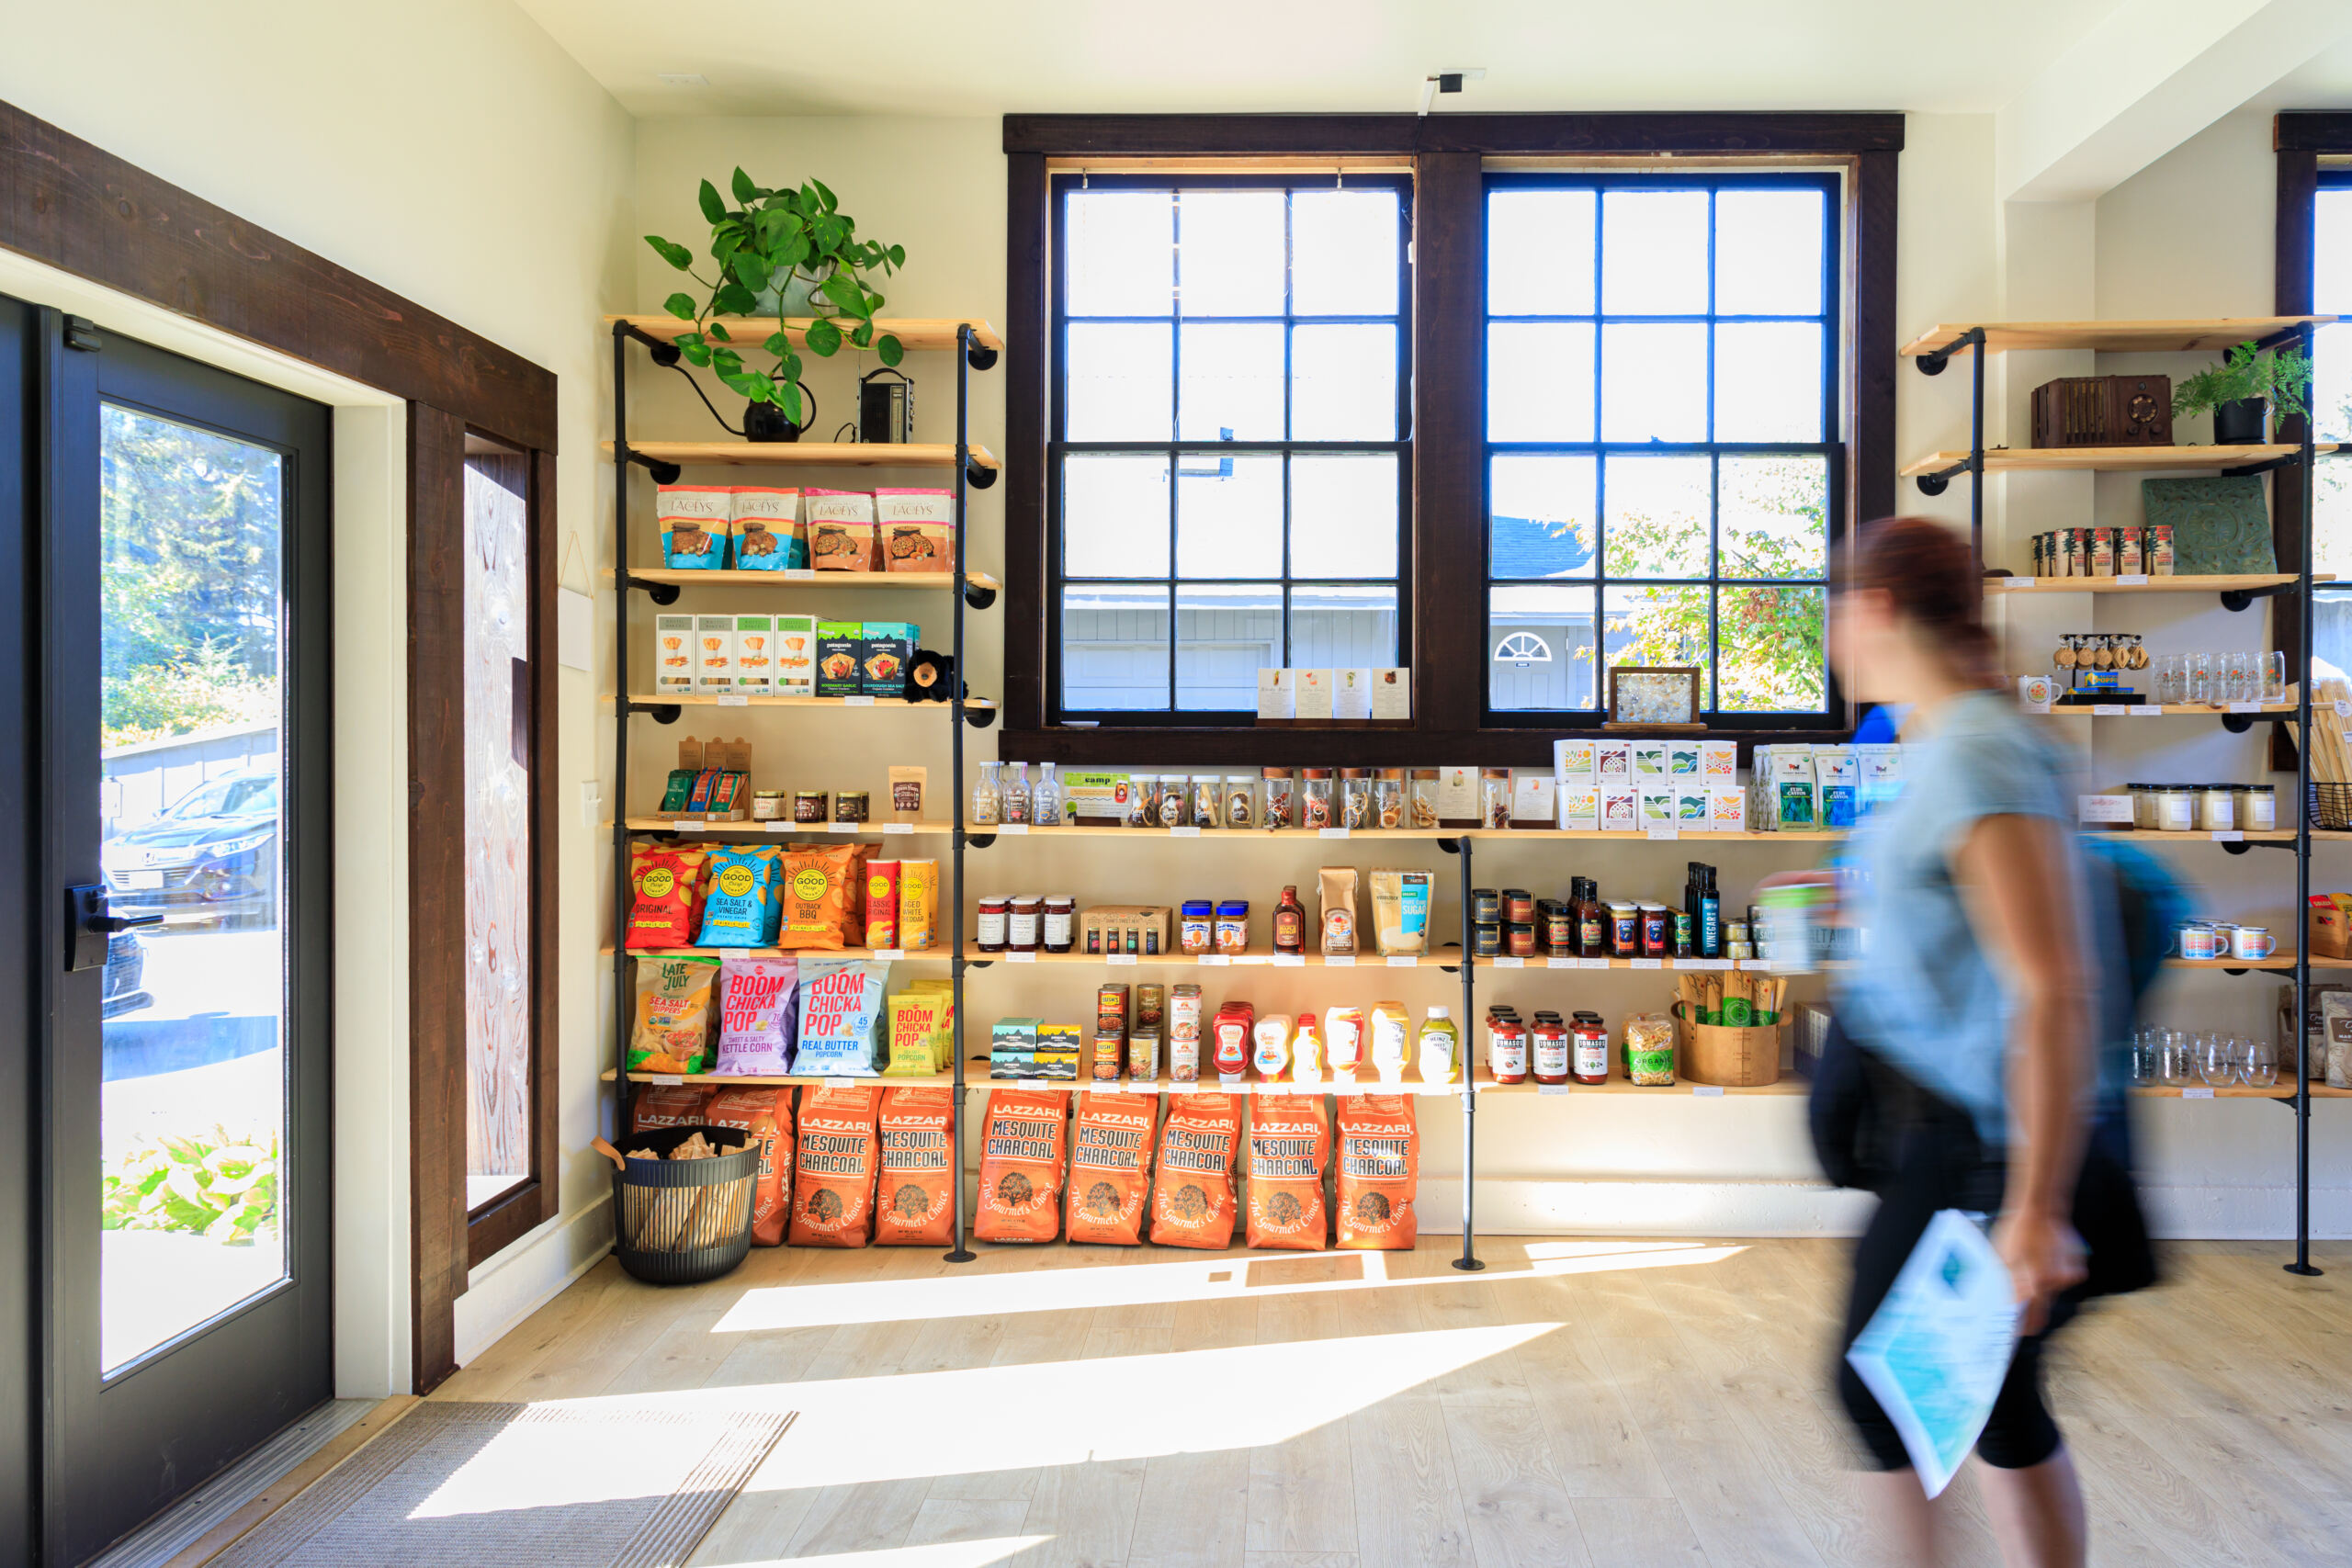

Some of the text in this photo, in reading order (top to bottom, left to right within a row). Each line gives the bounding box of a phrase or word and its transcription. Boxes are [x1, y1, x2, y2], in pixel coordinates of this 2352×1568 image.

[1085, 777, 1110, 785] camp
[636, 904, 673, 914] ORIGINAL
[717, 897, 728, 906] SEA
[730, 898, 746, 907] SALT
[1403, 905, 1426, 915] SUGAR
[718, 907, 747, 915] VINEGAR
[800, 909, 816, 919] BBQ
[1706, 917, 1716, 947] VINEGAR
[662, 963, 687, 978] LATE
[663, 975, 690, 990] JULY
[730, 975, 785, 996] BOOM
[812, 973, 865, 995] BOOM
[650, 997, 690, 1008] SEA SALT
[653, 1005, 681, 1014] DIPPERS
[726, 994, 775, 1010] CHICKA
[809, 996, 861, 1013] CHICKA
[724, 1011, 757, 1032] POP
[804, 1013, 842, 1036] POP
[858, 1017, 867, 1025] 45
[897, 1010, 933, 1022] BOOM
[897, 1022, 931, 1033] CHICKA
[722, 1043, 772, 1054] KETTLE CORN
[802, 1040, 858, 1050] REAL BUTTER
[895, 1033, 919, 1047] POP
[1637, 1056, 1671, 1065] ORGANIC
[639, 1114, 704, 1125] LAZZARI
[993, 1105, 1059, 1117] LAZZARI
[1080, 1111, 1148, 1126] LAZZARI
[801, 1117, 870, 1132] LAZZARI
[991, 1120, 1057, 1139] MESQUITE
[1170, 1114, 1233, 1129] LAZZARI
[1250, 1122, 1317, 1133] LAZZARI
[1341, 1122, 1410, 1134] LAZZARI
[801, 1134, 866, 1155] MESQUITE
[882, 1131, 947, 1149] MESQUITE
[1080, 1126, 1143, 1149] MESQUITE
[1166, 1130, 1230, 1152] MESQUITE
[988, 1138, 1055, 1158] CHARCOAL
[1251, 1139, 1316, 1157] MESQUITE
[1345, 1138, 1409, 1157] MESQUITE
[799, 1153, 865, 1174] CHARCOAL
[882, 1150, 948, 1168] CHARCOAL
[1075, 1146, 1138, 1168] CHARCOAL
[1165, 1148, 1226, 1171] CHARCOAL
[1251, 1158, 1317, 1175] CHARCOAL
[1343, 1157, 1408, 1175] CHARCOAL
[782, 1151, 791, 1202] AZZARI
[985, 1200, 1030, 1216] Gourmet's
[1031, 1182, 1053, 1210] Choice
[1074, 1207, 1119, 1224] Gourmet's
[1119, 1191, 1138, 1221] Choice
[797, 1213, 840, 1232] Gourmet's
[841, 1197, 864, 1226] Choice
[882, 1211, 926, 1228] Gourmet's
[928, 1190, 948, 1220] Choice
[1159, 1209, 1204, 1229] Gourmet's
[1206, 1194, 1225, 1223] Choice
[1255, 1216, 1300, 1235] Gourmet's
[1301, 1198, 1319, 1226] Choice
[1345, 1216, 1390, 1234] Gourmet's
[1390, 1198, 1408, 1226] Choice
